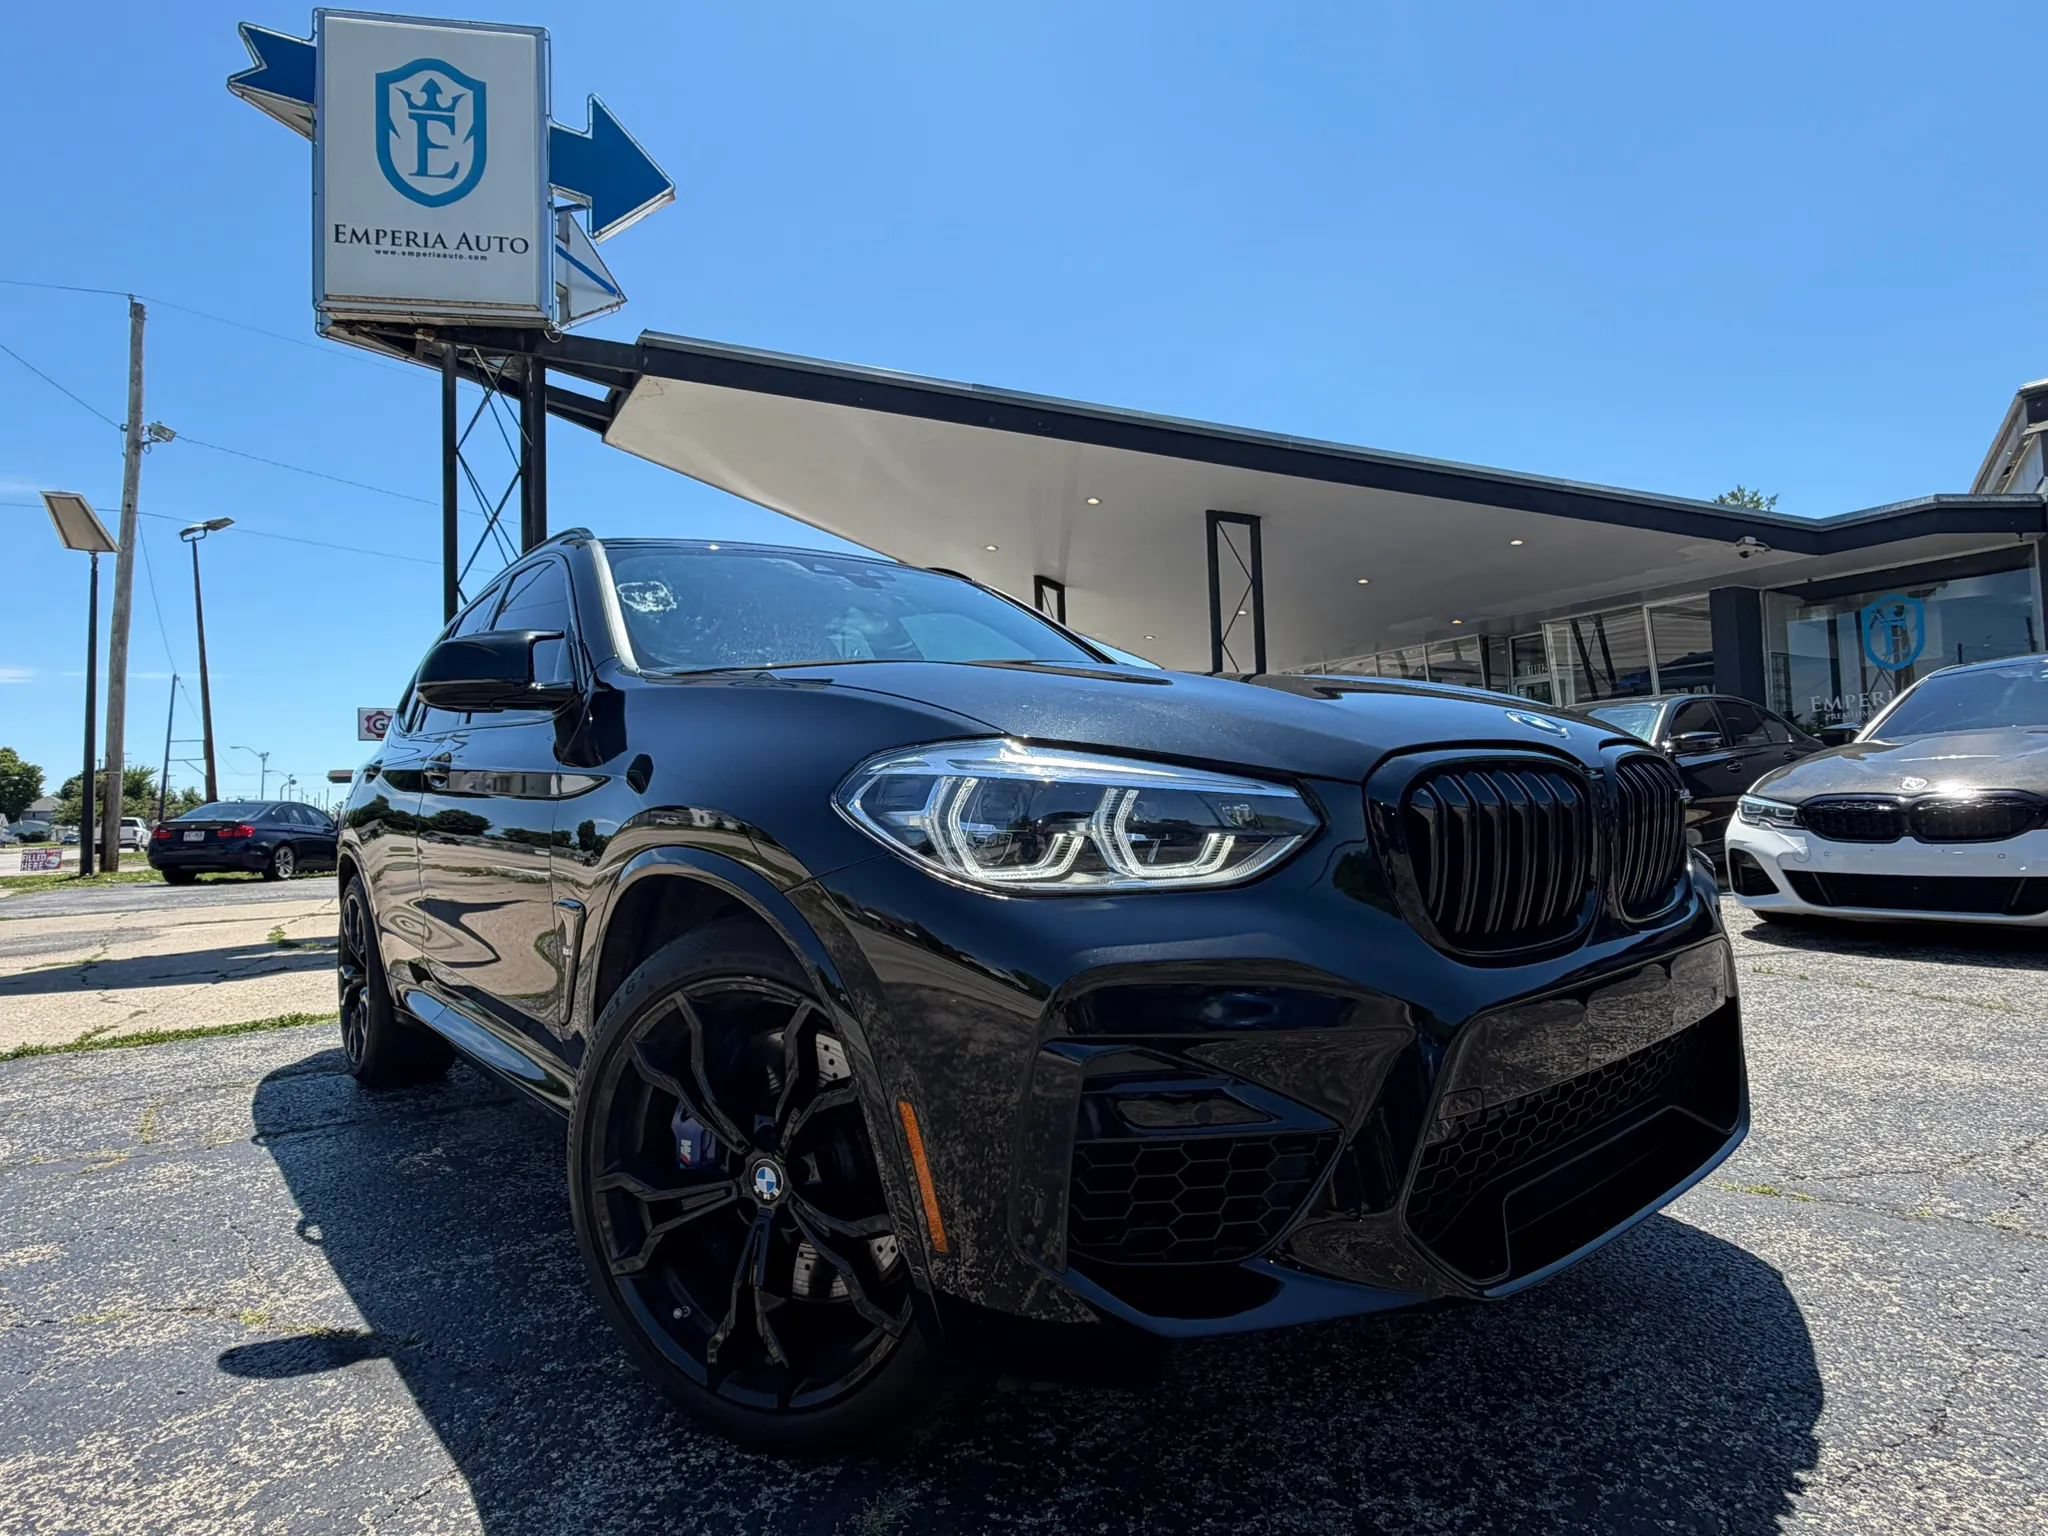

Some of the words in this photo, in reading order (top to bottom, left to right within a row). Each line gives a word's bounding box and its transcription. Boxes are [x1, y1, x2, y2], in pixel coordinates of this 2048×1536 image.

[408, 111, 460, 180] E
[333, 223, 449, 250] EMPERIA
[453, 231, 530, 255] AUTO
[374, 249, 488, 262] www.emperiaauto.com
[1809, 689, 1896, 713] EMPERI
[21, 861, 44, 871] HERE
[22, 853, 47, 863] FILLED
